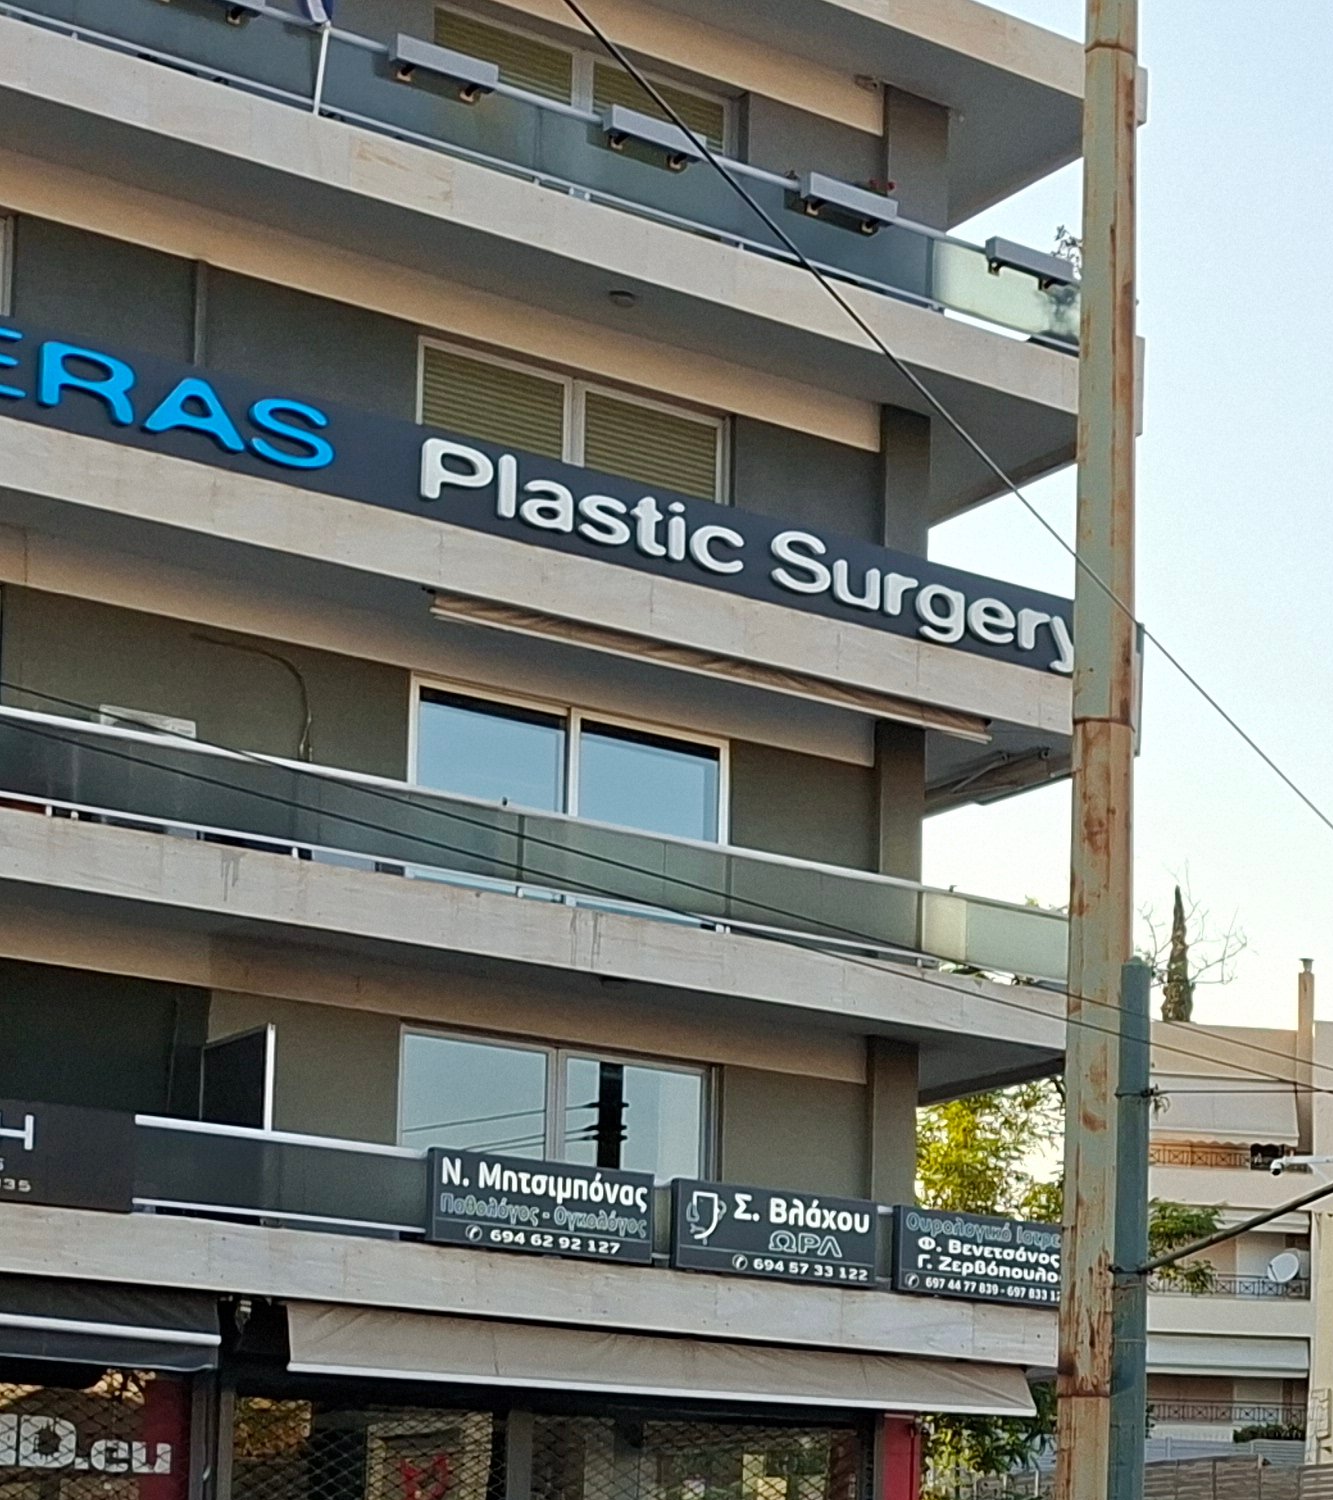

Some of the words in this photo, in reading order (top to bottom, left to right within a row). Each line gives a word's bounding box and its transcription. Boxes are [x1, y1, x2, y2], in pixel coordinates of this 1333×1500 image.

[420, 438, 744, 573] Plastic
[770, 530, 1075, 673] Surgery
[0, 1178, 31, 1192] 35
[478, 1161, 648, 1213] Μητσιμπόνας
[440, 1192, 539, 1227] Παθολόγος
[554, 1205, 648, 1239] Ογκολόγος
[733, 1192, 760, 1222] Σ.
[769, 1197, 870, 1233] Βλάχου
[490, 1228, 525, 1245] 694
[530, 1233, 553, 1248] 62
[559, 1237, 582, 1251] 92
[587, 1240, 621, 1255] 127
[768, 1229, 843, 1258] ΩΡΛ
[906, 1212, 1012, 1243] Ουρολογικό
[1016, 1226, 1062, 1251] Ιατρε
[917, 1236, 942, 1252] Φ.
[948, 1239, 1060, 1269] Βενετσάνος
[753, 1258, 784, 1272] 694
[788, 1261, 809, 1275] 57
[814, 1264, 833, 1277] 33
[839, 1266, 868, 1281] 122
[917, 1254, 932, 1270] Γ.
[938, 1256, 1062, 1284] Ζερβόπουλο
[925, 1276, 945, 1290] 697
[963, 1280, 977, 1293] 77
[1007, 1285, 1026, 1299] 697
